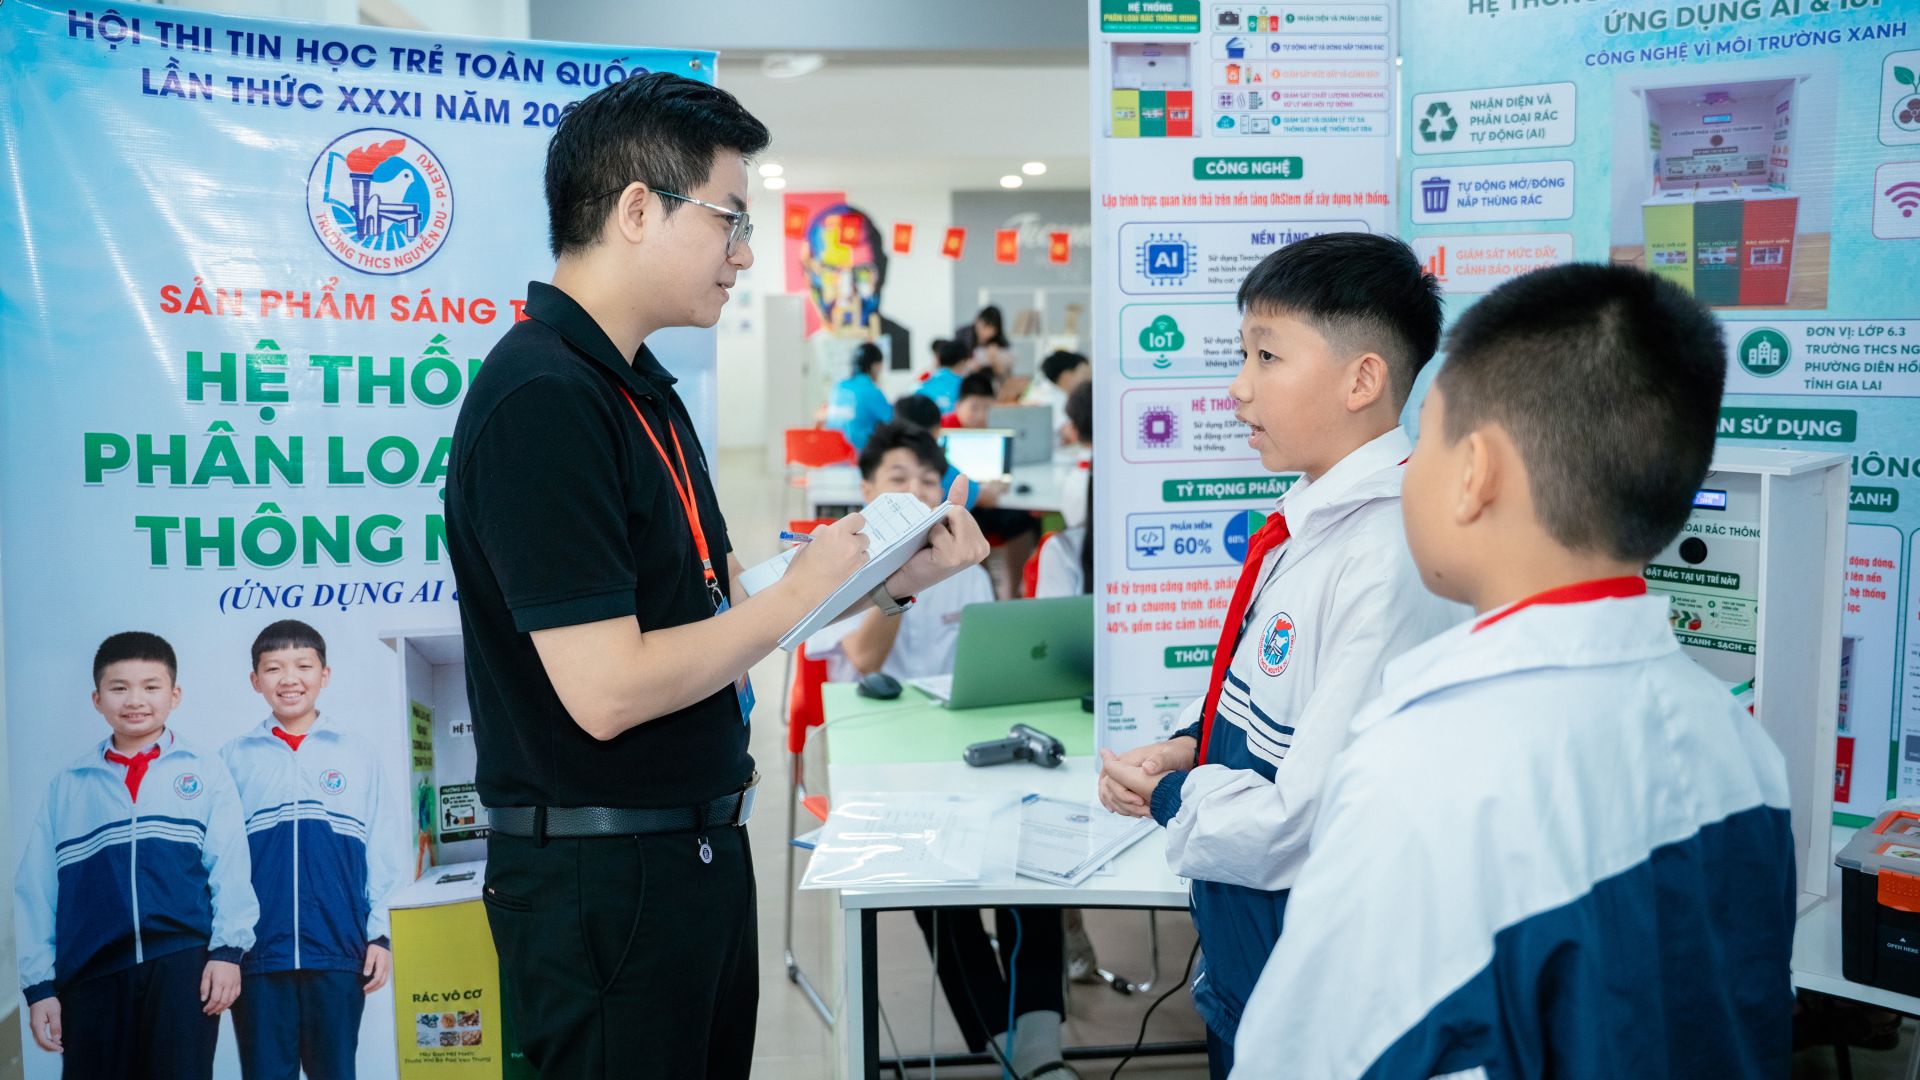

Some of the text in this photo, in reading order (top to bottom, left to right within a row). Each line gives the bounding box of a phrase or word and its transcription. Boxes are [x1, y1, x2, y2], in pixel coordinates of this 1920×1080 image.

[1604, 9, 1667, 34] ỨNG
[1676, 1, 1761, 31] DỤNG
[68, 9, 140, 50] HỘI
[155, 21, 212, 52] THI
[226, 30, 281, 60] TIN
[297, 39, 377, 71] HỌC
[390, 44, 444, 74] TRẺ
[456, 50, 544, 83] TOÀN
[1585, 22, 1906, 66] CÔNG NGHỆ VÌ MÔI TRƯỜNG XANH
[142, 57, 559, 127] LẦN THỨC XXXI NĂM 20
[1470, 93, 1551, 112] NHẬN DIỆN VÀ
[1470, 109, 1558, 126] PHÂN LOẠI RÁC
[1470, 128, 1545, 144] TỰ ĐỘNG (AI)
[1206, 159, 1291, 177] CÔNG NGHỆ
[1458, 177, 1565, 195] TỰ ĐỘNG MỞ/ĐÓNG
[1457, 194, 1542, 208] NẮP THÙNG RÁC
[316, 153, 448, 269] TRƯỜNG THCS NGUYỄN DU PLEIKU
[1251, 230, 1275, 245] NỀN
[1154, 251, 1178, 268] AI
[1456, 247, 1483, 260] GIÁM
[1486, 246, 1504, 259] SÁT
[1507, 244, 1532, 258] MỨC
[1456, 263, 1485, 275] CẢNH
[1488, 263, 1510, 275] BÁO
[160, 276, 242, 317] SẢN
[260, 276, 375, 320] PHẨM
[391, 288, 497, 324] SÁNG
[1149, 332, 1174, 348] IoT
[1807, 324, 1906, 340] ĐƠN VỊ: LỚP 6.3
[1806, 342, 1897, 355] TRƯỜNG THCS
[1804, 360, 1894, 373] PHƯỜNG DIÊN
[186, 333, 485, 421] HỆ THỐ
[1804, 377, 1882, 390] TỈNH GIA LAI
[1192, 396, 1239, 414] HỆ THỐN
[1741, 415, 1772, 434] SỬ
[1777, 419, 1842, 440] DỤNG
[84, 420, 303, 486] PHÂN
[1176, 481, 1195, 497] TỶ
[1197, 484, 1246, 498] TRỌNG
[1249, 479, 1286, 494] PHẦN
[135, 502, 404, 568] THÔNG
[1706, 524, 1726, 536] RÁC
[1174, 537, 1211, 554] 60%
[1849, 556, 1869, 568] động
[1645, 567, 1737, 586] ĐẶT RÁC TẠI VỊ TRÍ NÀY
[219, 579, 304, 614] (ỨNG
[313, 581, 404, 611] DỤNG
[409, 580, 445, 604] AI
[1850, 587, 1886, 600] hệ thống
[1848, 603, 1860, 613] lọc
[1687, 637, 1711, 646] XANH
[1717, 641, 1742, 651] SẠCH
[1175, 649, 1209, 663] THỜI
[453, 722, 464, 735] HỆ
[412, 989, 483, 1002] RÁC VÔ CƠ
